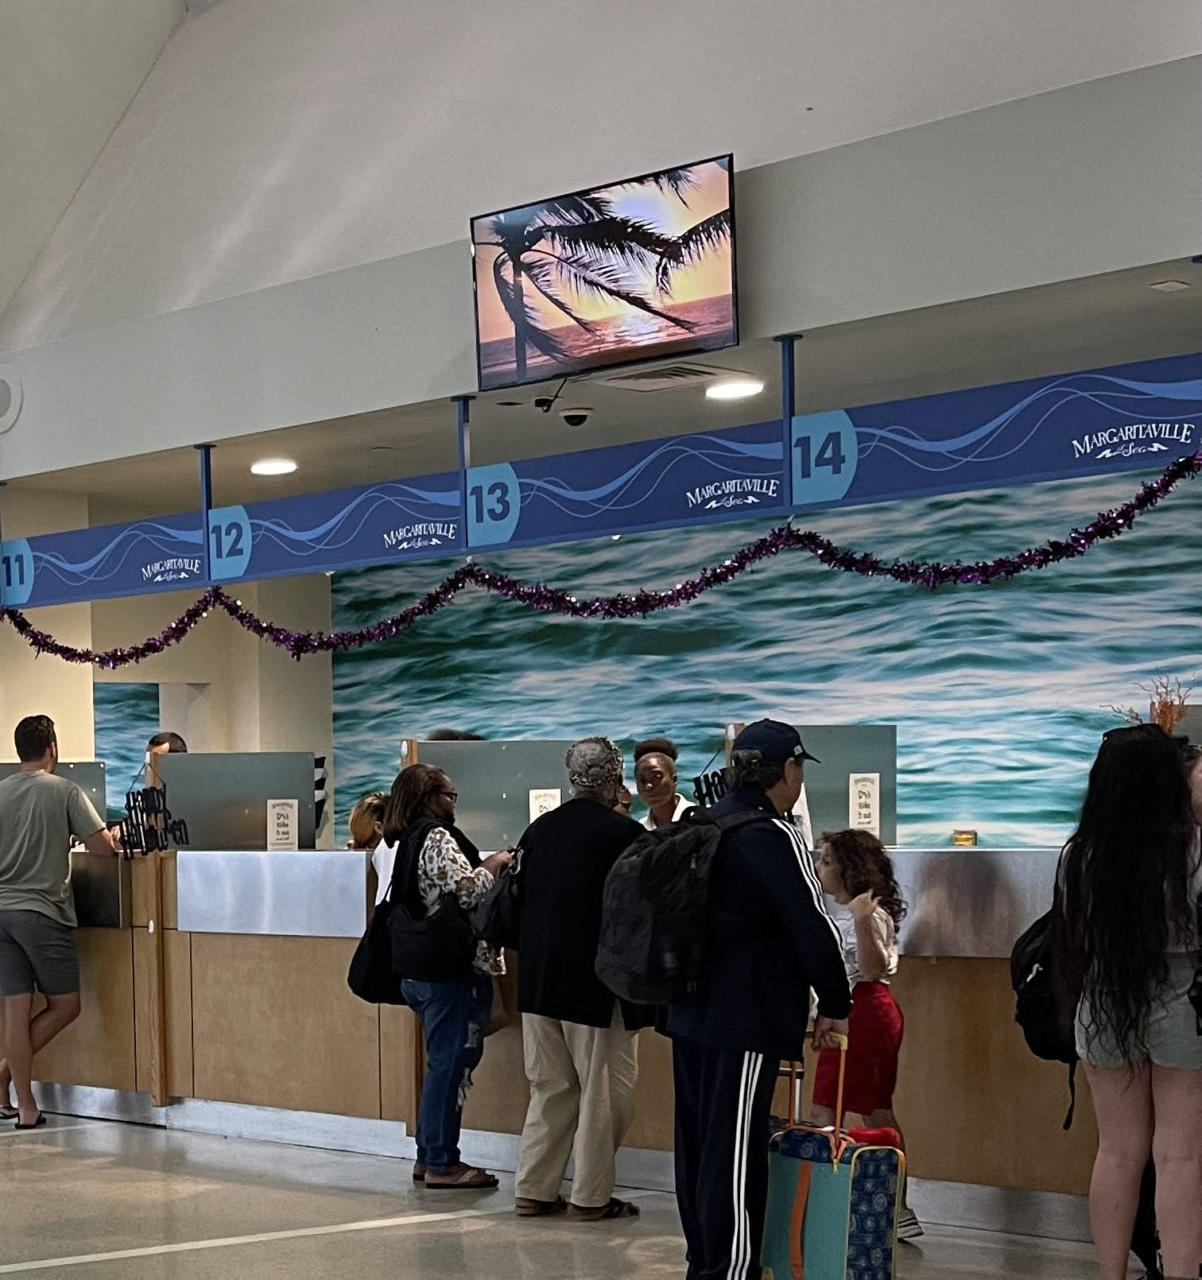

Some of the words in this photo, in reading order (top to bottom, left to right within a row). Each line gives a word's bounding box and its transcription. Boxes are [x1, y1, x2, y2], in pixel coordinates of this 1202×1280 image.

[793, 431, 846, 479] 14
[1071, 423, 1195, 458] MARGARITAVILLE
[469, 481, 511, 524] 13
[685, 478, 780, 508] MARGARITAVILLE
[210, 521, 244, 559] 12
[383, 522, 458, 548] MARGARITAVILLE
[1, 553, 25, 587] 11
